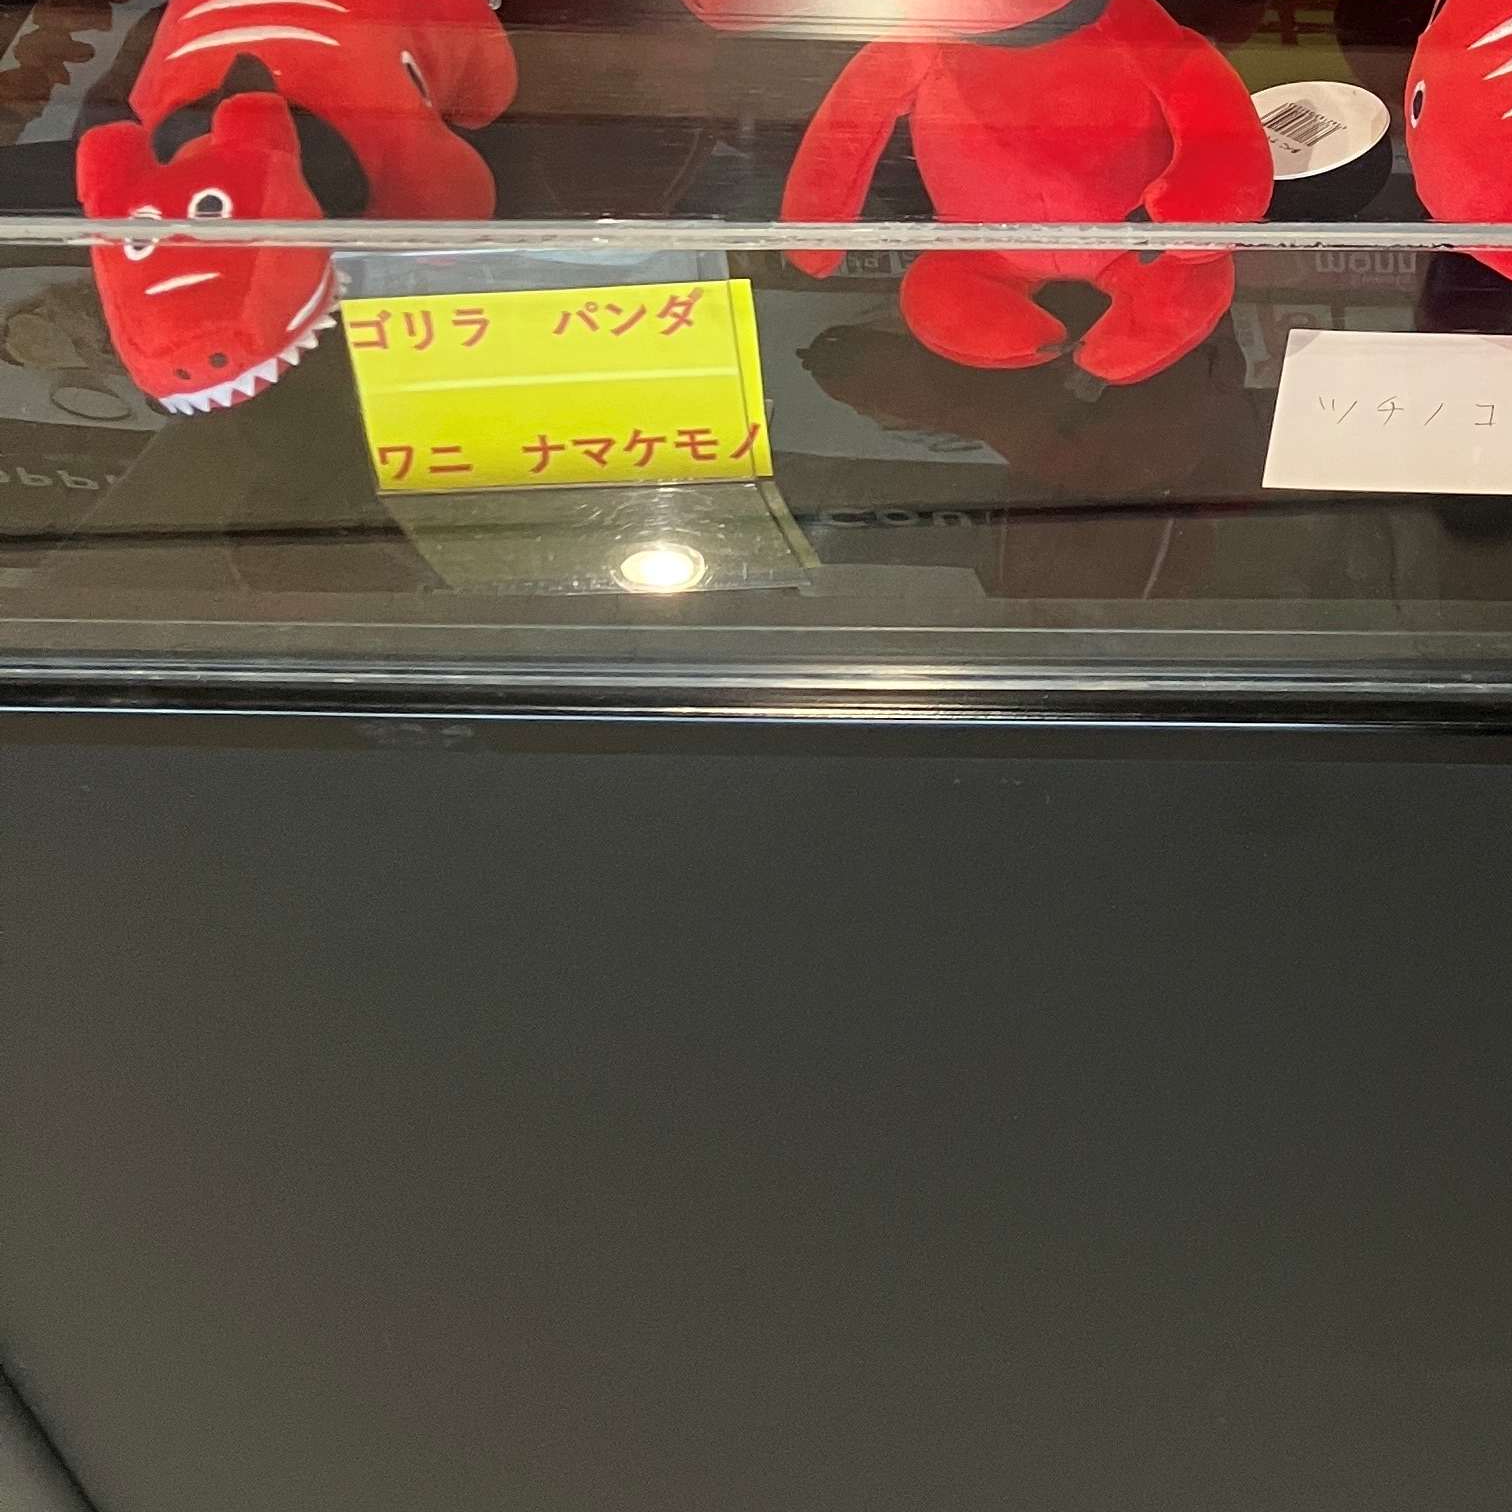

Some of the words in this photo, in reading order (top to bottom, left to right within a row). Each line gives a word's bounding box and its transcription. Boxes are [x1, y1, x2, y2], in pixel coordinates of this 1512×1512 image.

[349, 310, 490, 351] ゴリラ
[552, 288, 706, 338] パンダ
[378, 445, 472, 479] ワニ
[522, 423, 761, 475] ナマケモノ
